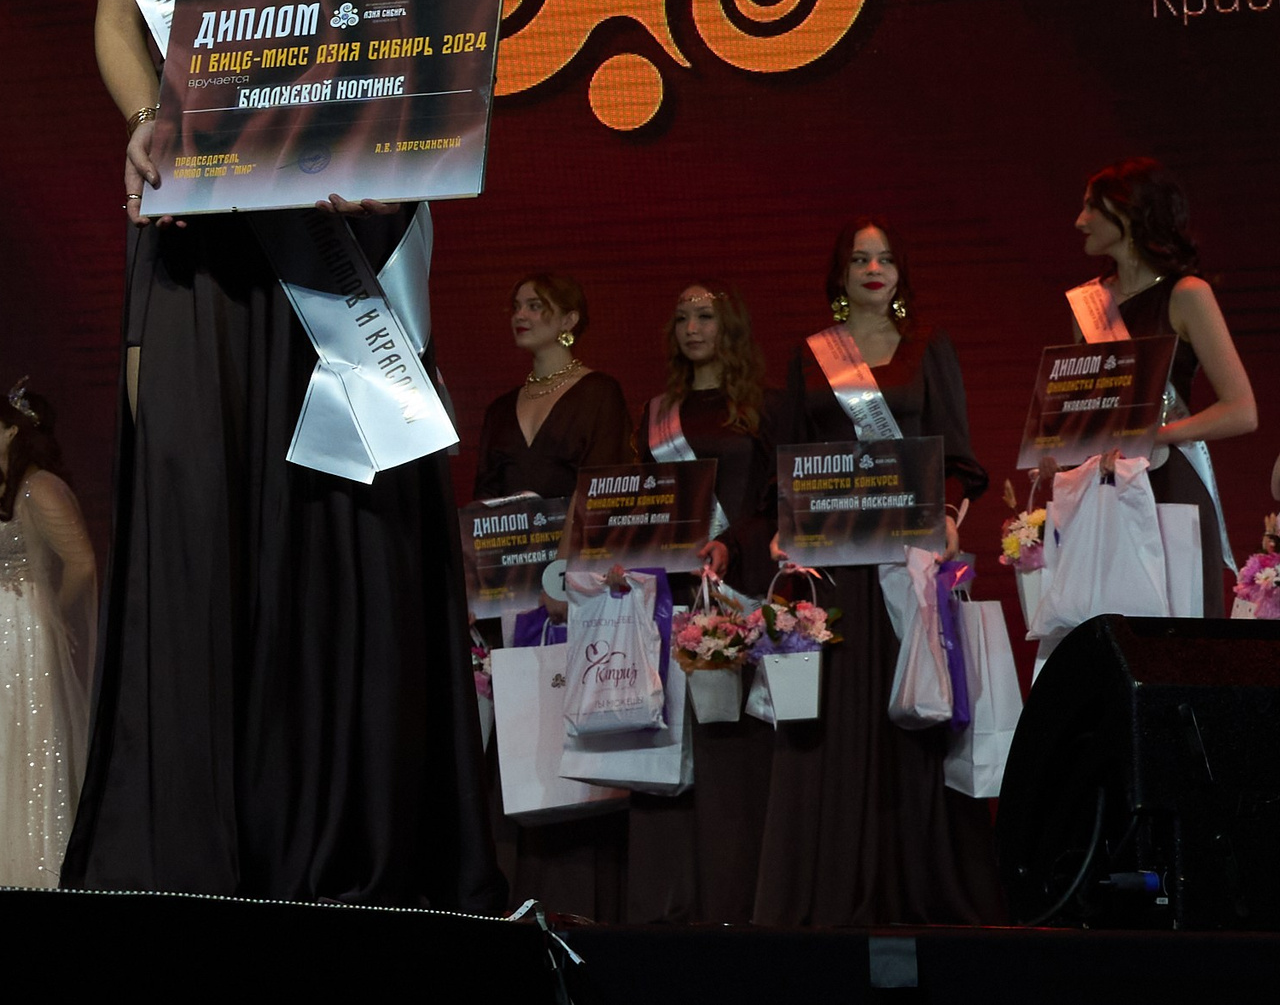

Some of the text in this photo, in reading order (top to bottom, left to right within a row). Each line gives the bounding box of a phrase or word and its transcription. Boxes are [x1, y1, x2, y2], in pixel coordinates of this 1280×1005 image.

[194, 2, 320, 49] ДИПЛОМ
[190, 31, 487, 74] II ВИЦЕ-МИСС АЗИЯ СИБИРЬ 2024
[188, 74, 250, 89] вручается
[336, 75, 405, 98] НОМИНЕ
[396, 135, 461, 153] ЗАРЕЧАНСКИЙ
[175, 153, 239, 167] ПРЕДСЕДАТЕЛЬ
[355, 308, 379, 328] И
[1049, 355, 1103, 381] ДИПЛОМ
[792, 454, 855, 478] ДИПЛОМ
[587, 475, 641, 497] ДИПЛОМ
[854, 475, 899, 488] КОНКУРСА
[473, 512, 529, 537] ДИПЛОМ
